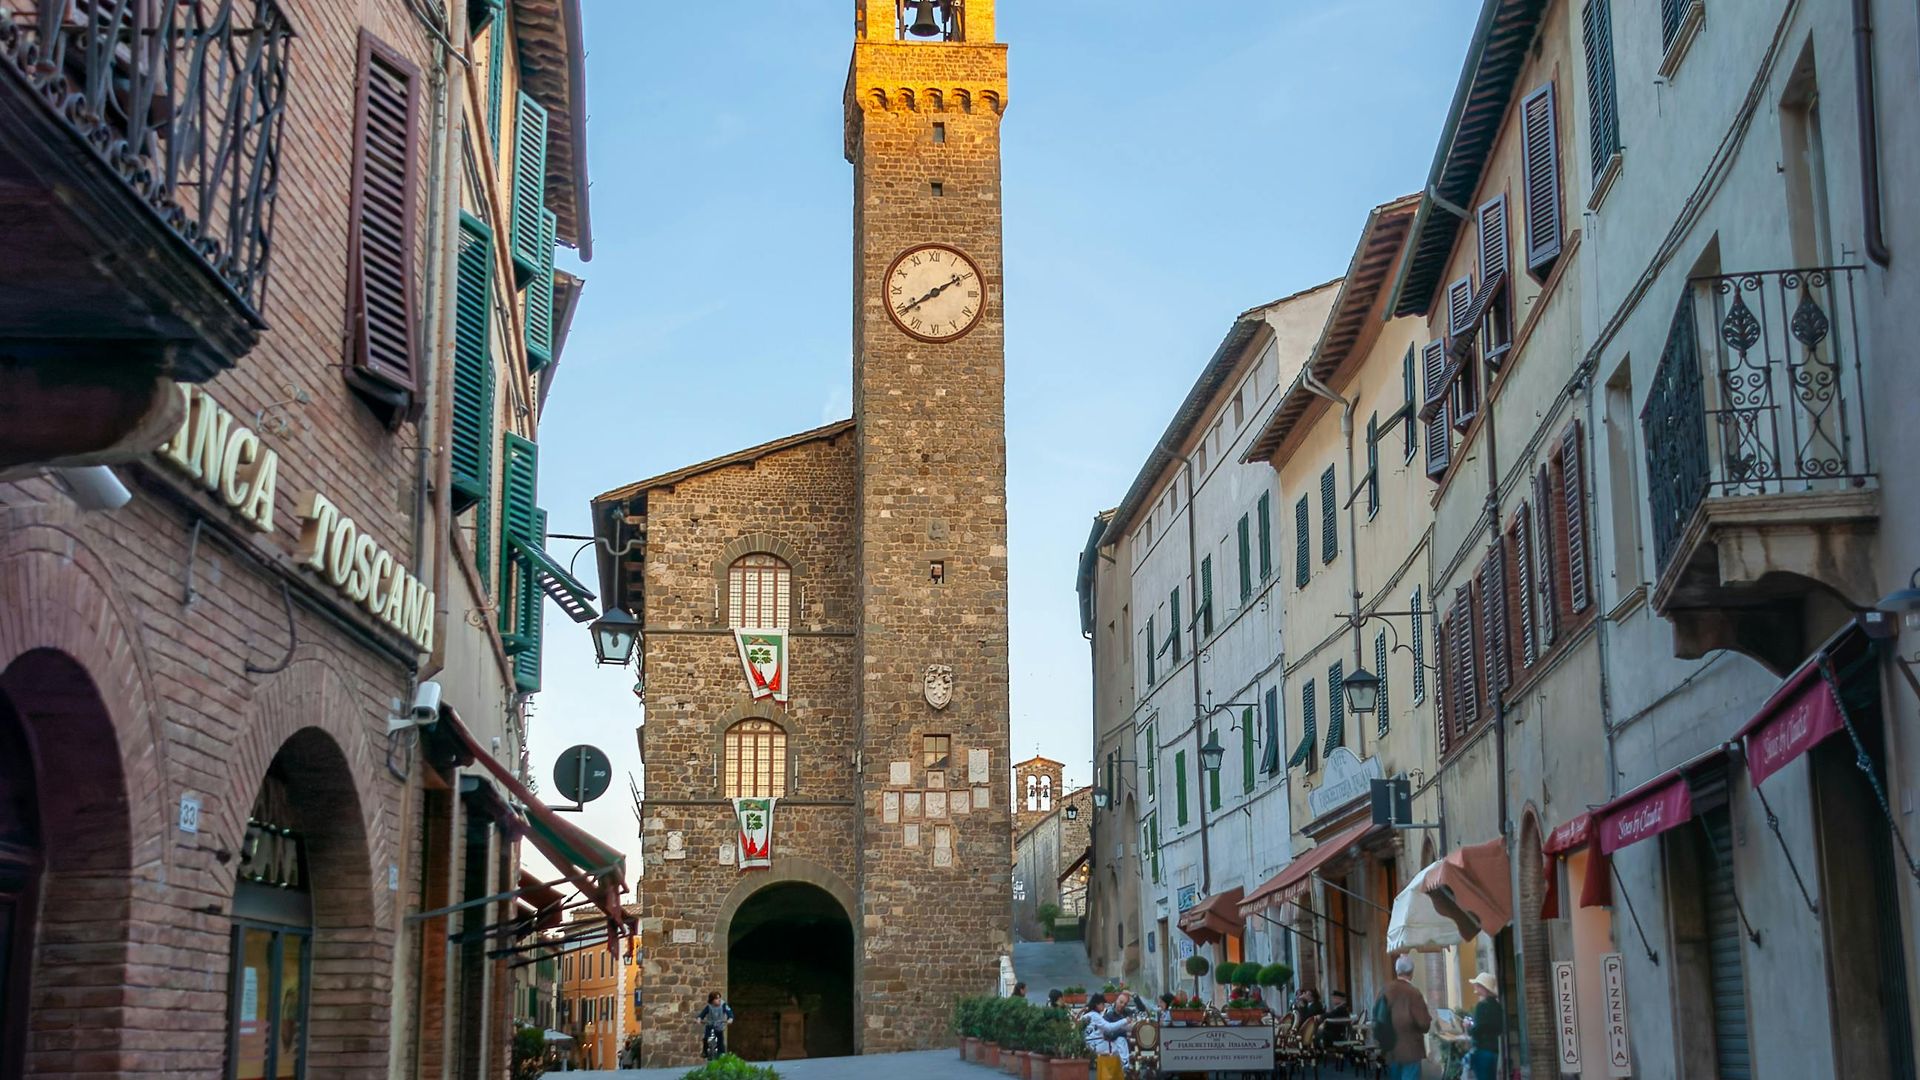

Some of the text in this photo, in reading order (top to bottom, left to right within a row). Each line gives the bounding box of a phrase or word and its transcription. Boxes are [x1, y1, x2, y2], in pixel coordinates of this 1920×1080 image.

[911, 255, 921, 267] XI
[929, 251, 940, 262] XII
[950, 257, 958, 267] I
[896, 269, 908, 278] X
[891, 285, 902, 295] IX
[961, 306, 973, 317] IV
[910, 317, 922, 330] VII
[931, 324, 939, 334] VI
[949, 319, 958, 331] V
[300, 493, 435, 653] TOSCANA
[183, 804, 196, 825] 33
[1560, 971, 1575, 1058] PIZZERIA
[1608, 963, 1625, 1060] PIZZERIA
